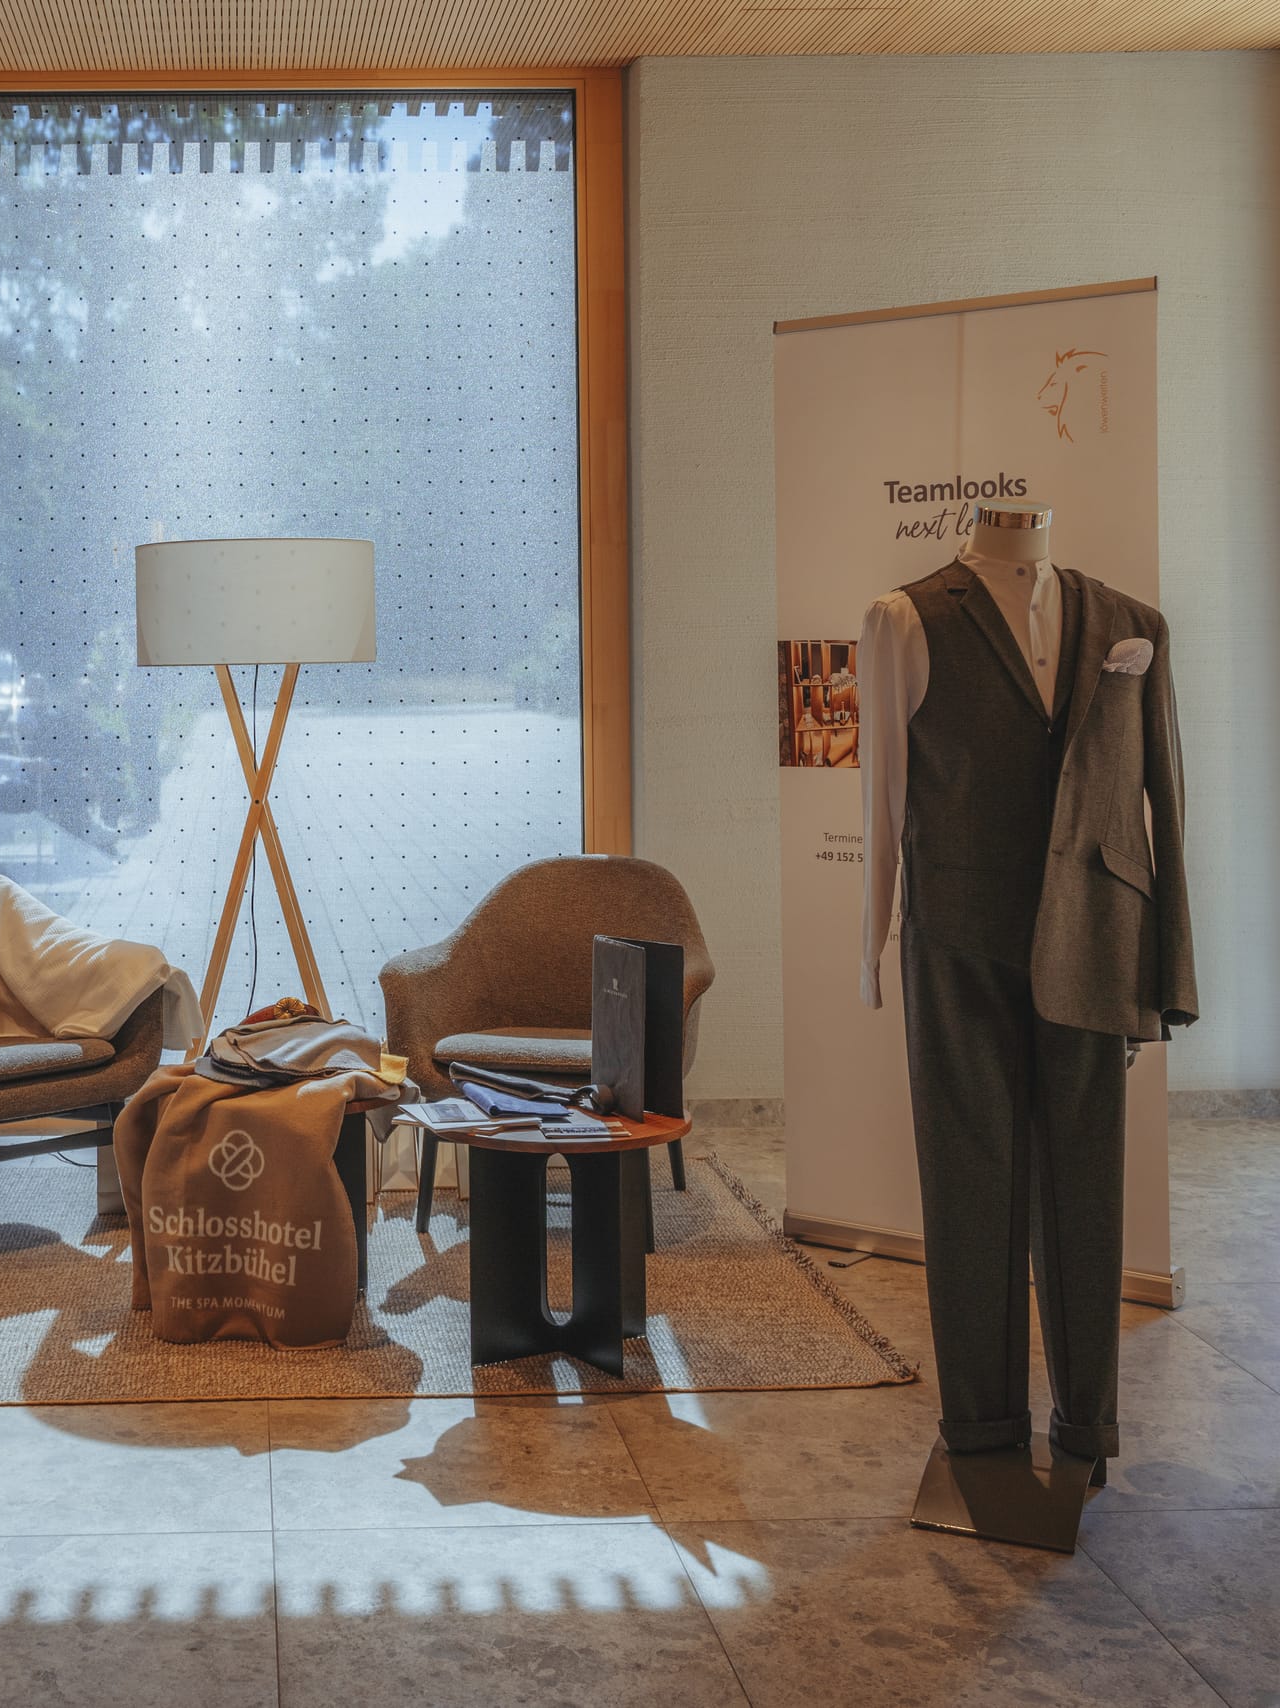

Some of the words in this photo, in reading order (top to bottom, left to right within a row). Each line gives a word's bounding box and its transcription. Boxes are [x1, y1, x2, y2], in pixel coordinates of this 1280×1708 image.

[883, 472, 1027, 504] Teamlooks
[895, 507, 957, 540] next
[823, 832, 863, 843] Termine
[816, 851, 834, 861] +49
[836, 852, 855, 862] 152
[149, 1206, 322, 1251] Schlosshotel
[165, 1244, 297, 1286] Kitzbühel
[170, 1296, 193, 1309] THE
[197, 1297, 218, 1309] SPA
